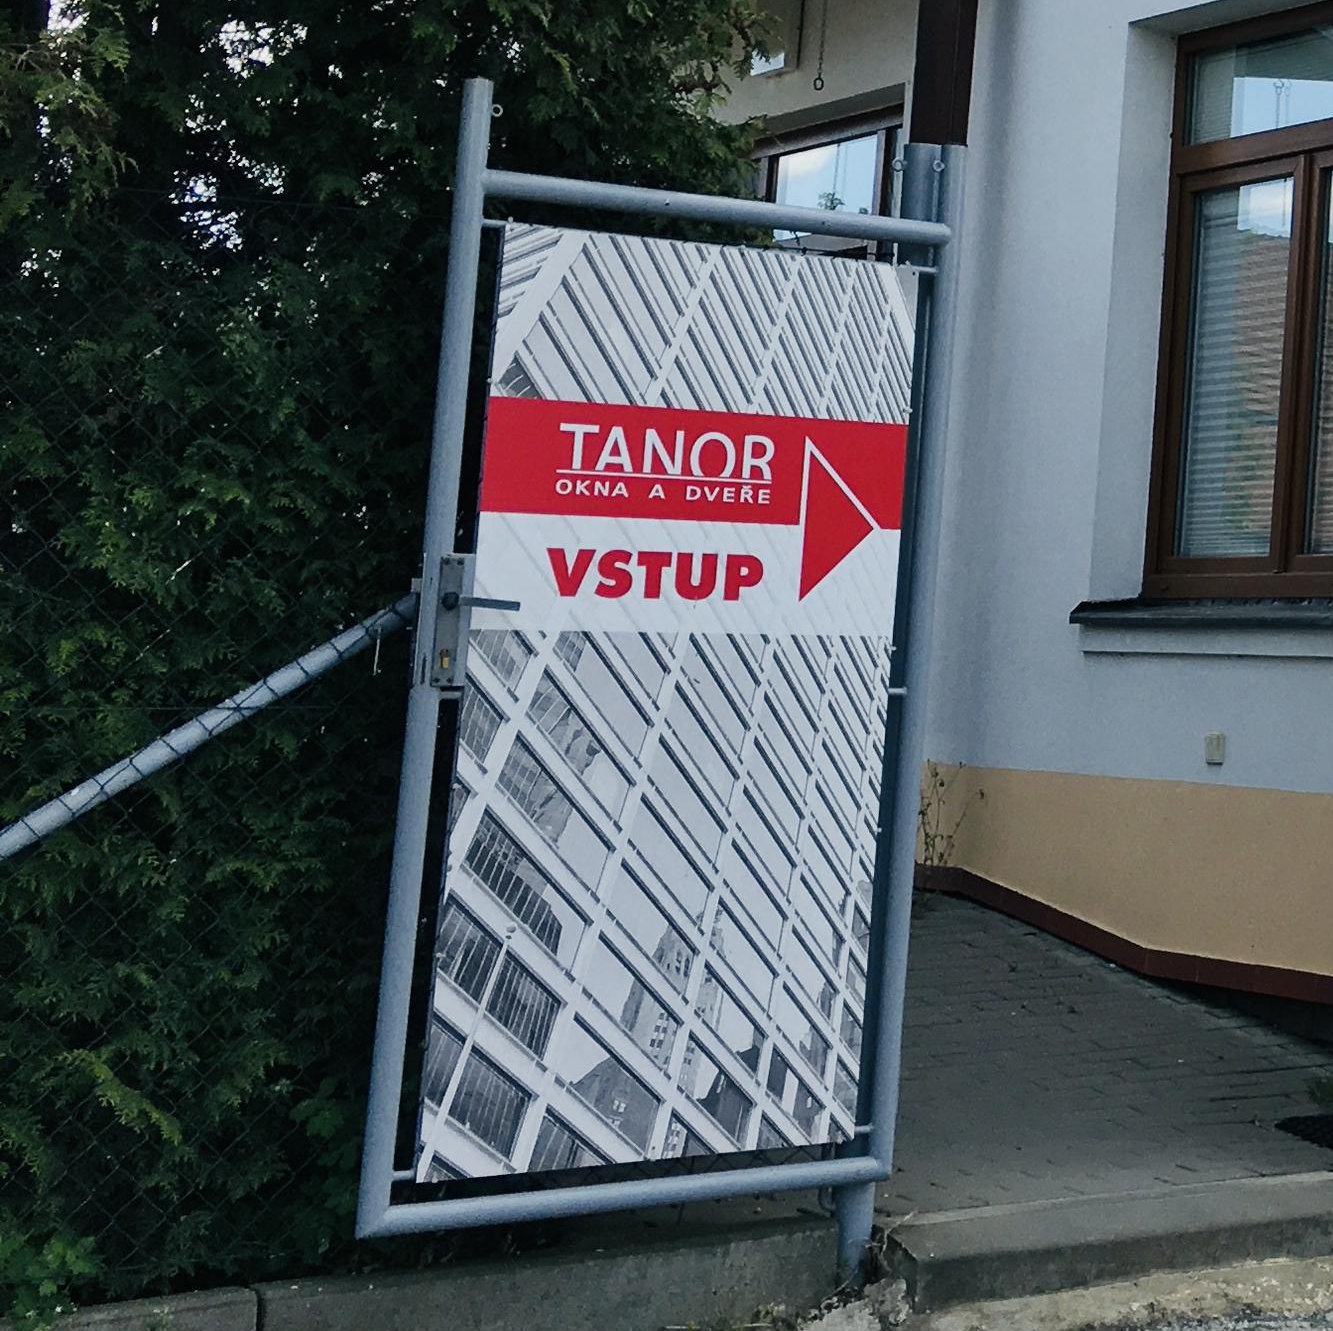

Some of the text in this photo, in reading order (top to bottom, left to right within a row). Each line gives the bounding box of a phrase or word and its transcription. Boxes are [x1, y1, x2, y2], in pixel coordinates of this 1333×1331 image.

[559, 422, 776, 481] TANOR
[555, 478, 771, 504] OKNA A DVEŘE
[546, 547, 765, 602] VSTUP
